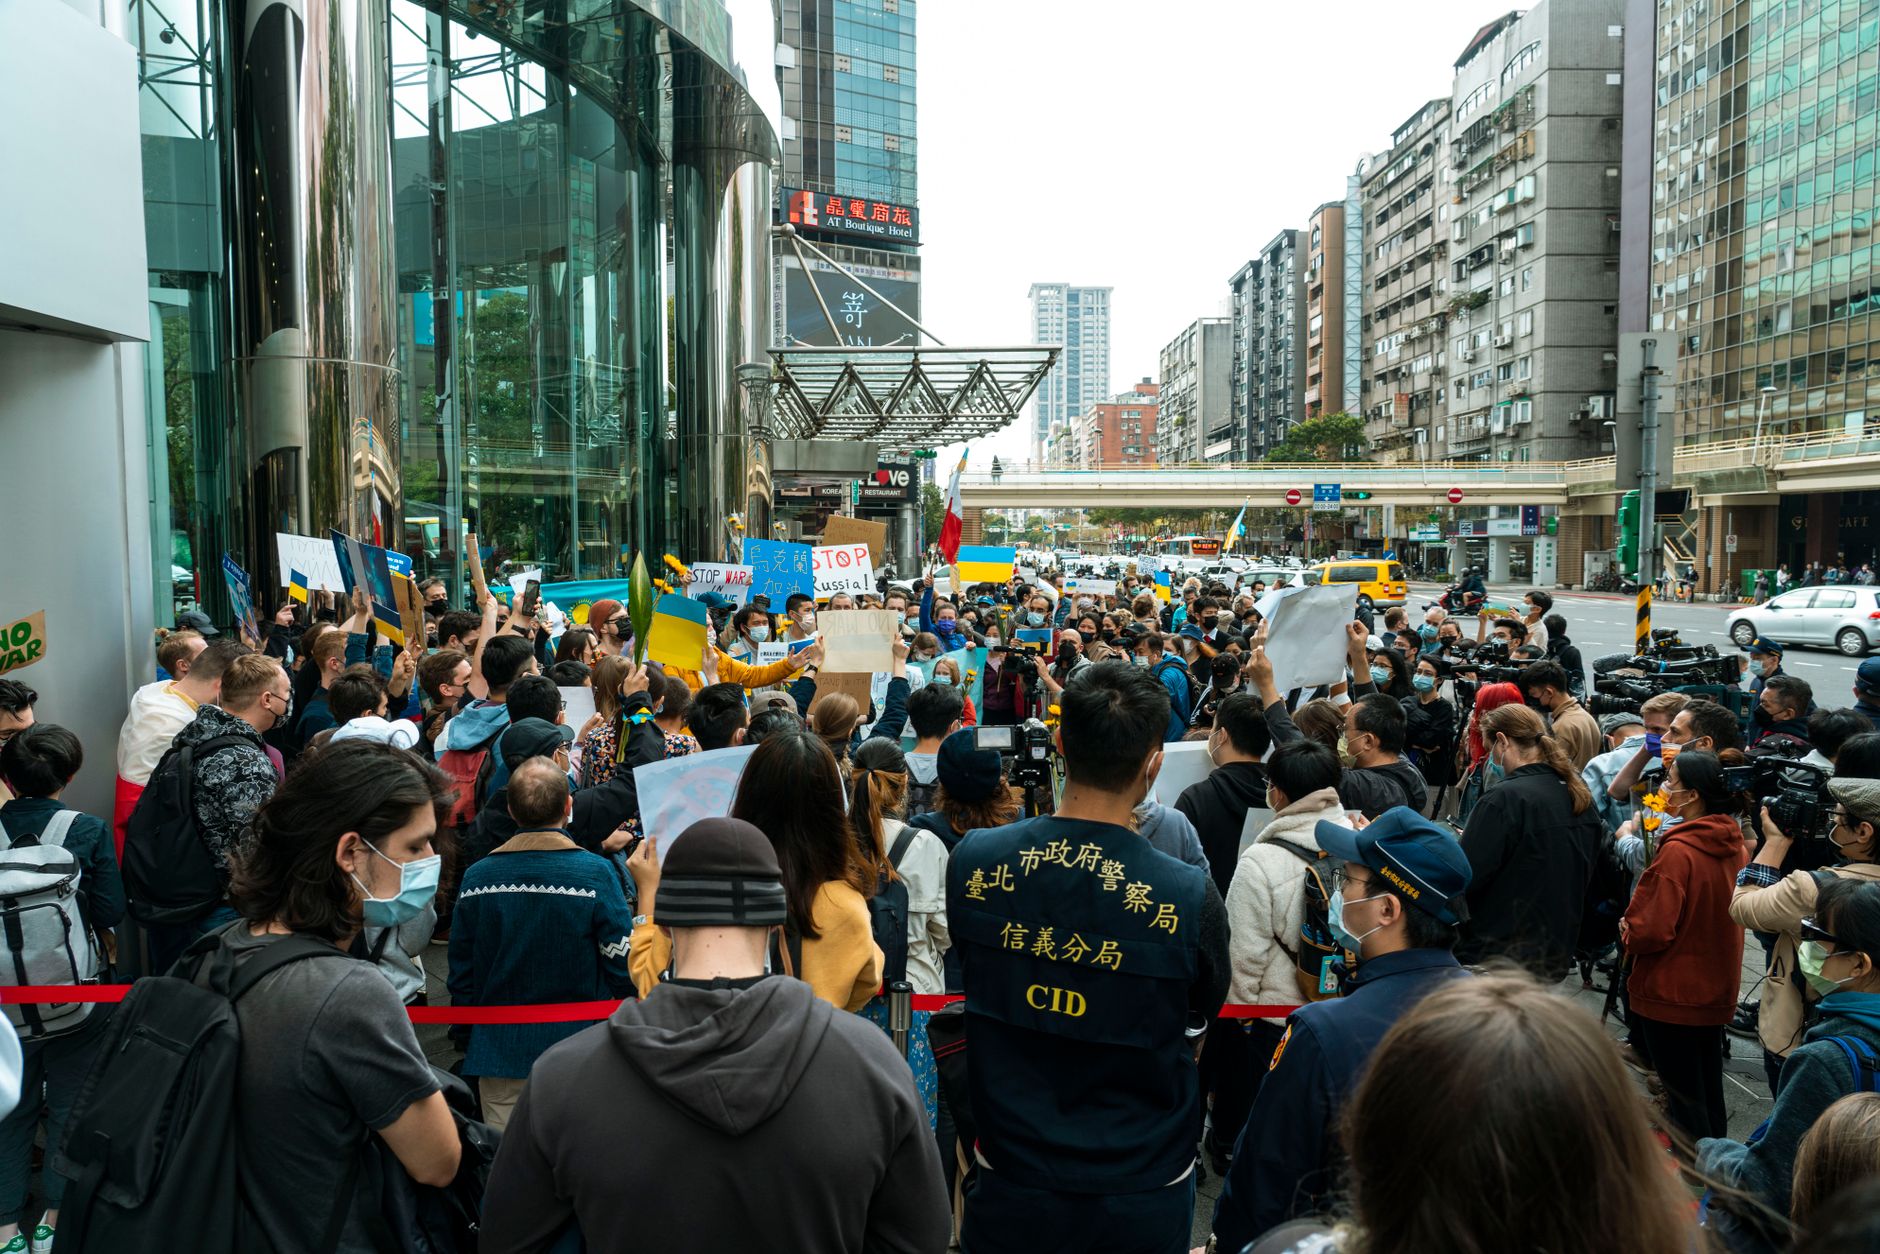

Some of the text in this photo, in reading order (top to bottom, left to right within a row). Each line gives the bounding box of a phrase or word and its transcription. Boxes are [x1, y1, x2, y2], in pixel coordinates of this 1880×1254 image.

[827, 217, 912, 238] AT Boutique Hotel
[813, 547, 867, 571] STOP
[692, 568, 747, 584] STOP WAR
[763, 577, 801, 597] 加油
[711, 585, 724, 593] IN
[966, 839, 1179, 935] 臺北市政府警察局
[1000, 921, 1123, 971] 信義分局
[1026, 984, 1087, 1017] CID
